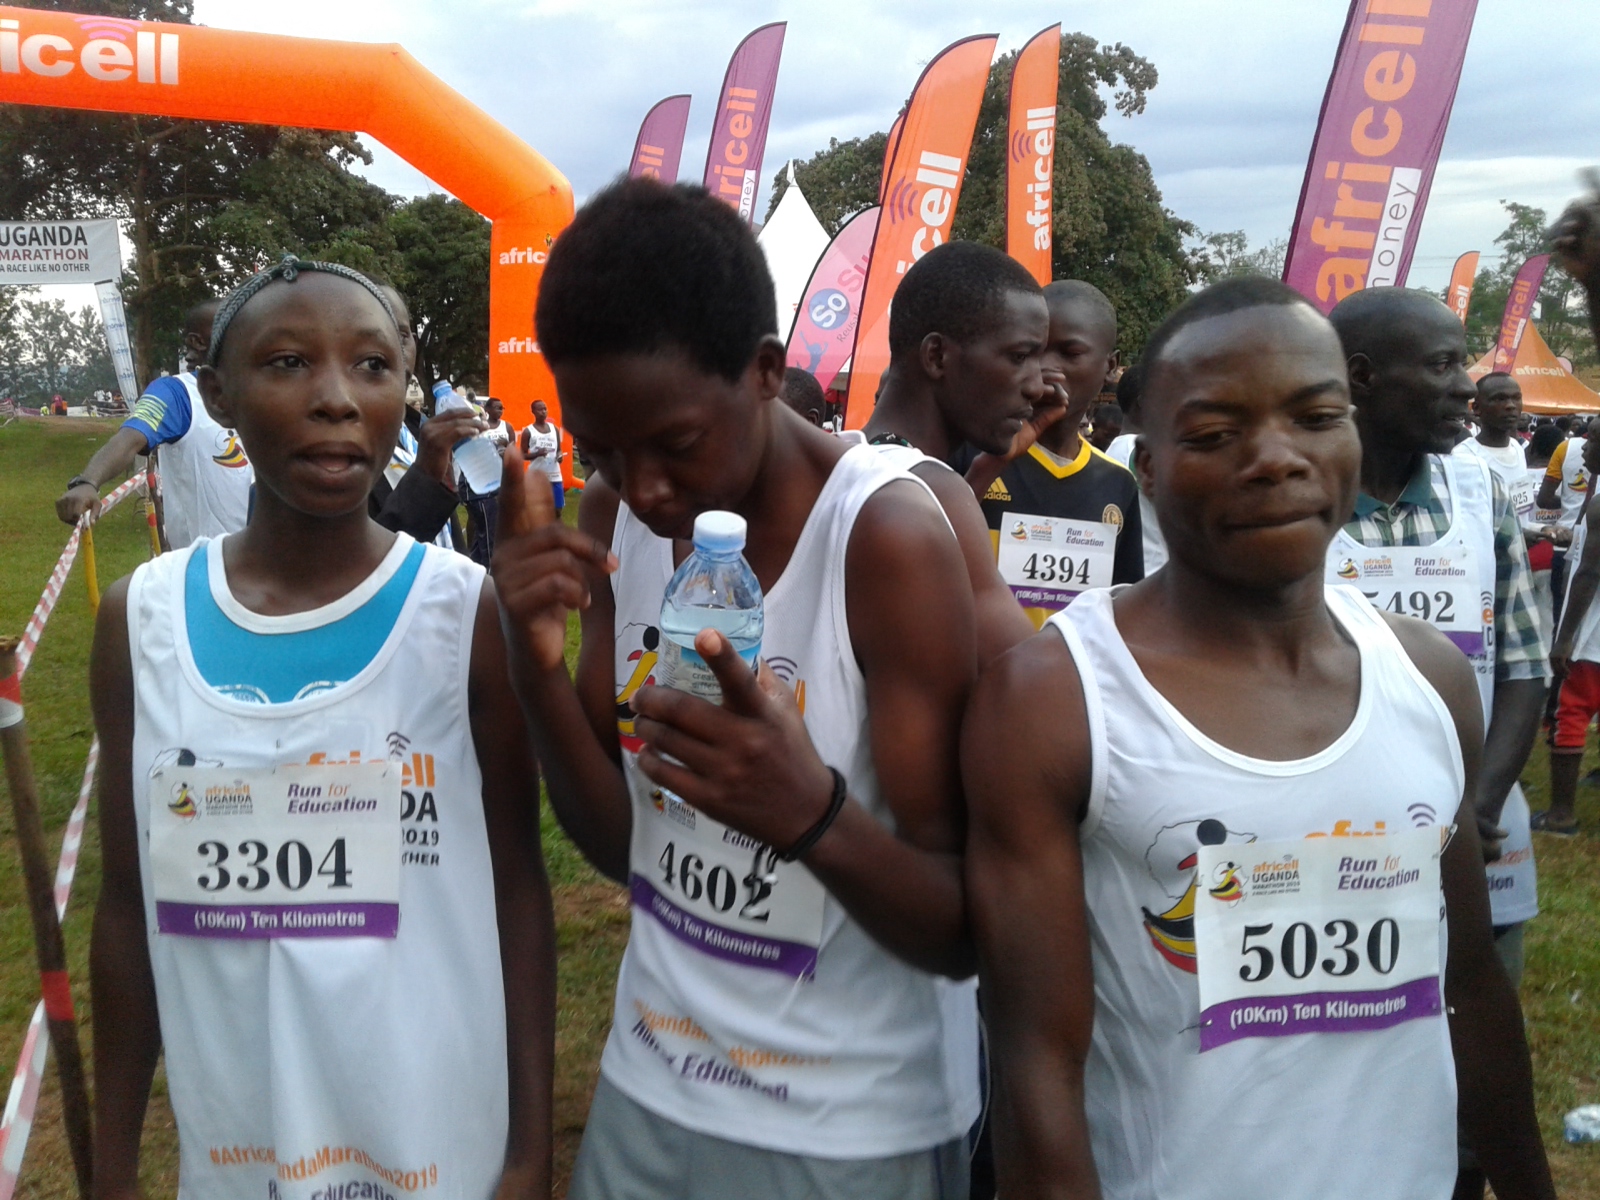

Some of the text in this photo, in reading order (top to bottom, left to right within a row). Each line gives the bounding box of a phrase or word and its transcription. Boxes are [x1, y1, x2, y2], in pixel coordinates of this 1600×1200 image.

[1310, 0, 1432, 303] africell
[1026, 106, 1056, 250] africell
[0, 226, 88, 247] UGANDA
[0, 248, 89, 261] MARATHON
[7, 264, 27, 272] RACE
[30, 264, 47, 273] LIKE
[49, 263, 61, 272] NO
[63, 263, 90, 272] OTHER
[1502, 280, 1532, 349] africell
[1066, 528, 1082, 536] Run
[1066, 537, 1105, 547] Education
[1023, 553, 1091, 585] 4394
[1414, 557, 1451, 566] Run for
[1415, 567, 1466, 576] Education
[205, 795, 252, 804] UGANDA
[288, 783, 351, 797] Run for
[288, 797, 377, 814] Education
[197, 837, 352, 892] 3304
[1253, 859, 1299, 873] africell
[1338, 855, 1401, 872] Run for
[658, 840, 772, 925] 4602
[1252, 872, 1300, 884] UGANDA
[1337, 868, 1420, 890] Education
[194, 910, 366, 931] (10Km) Ten Kilometres
[683, 916, 703, 939] Ten
[704, 926, 781, 961] Kilometres
[1239, 918, 1400, 982] 5030
[1230, 995, 1407, 1030] (10Km) Ten Kilometres
